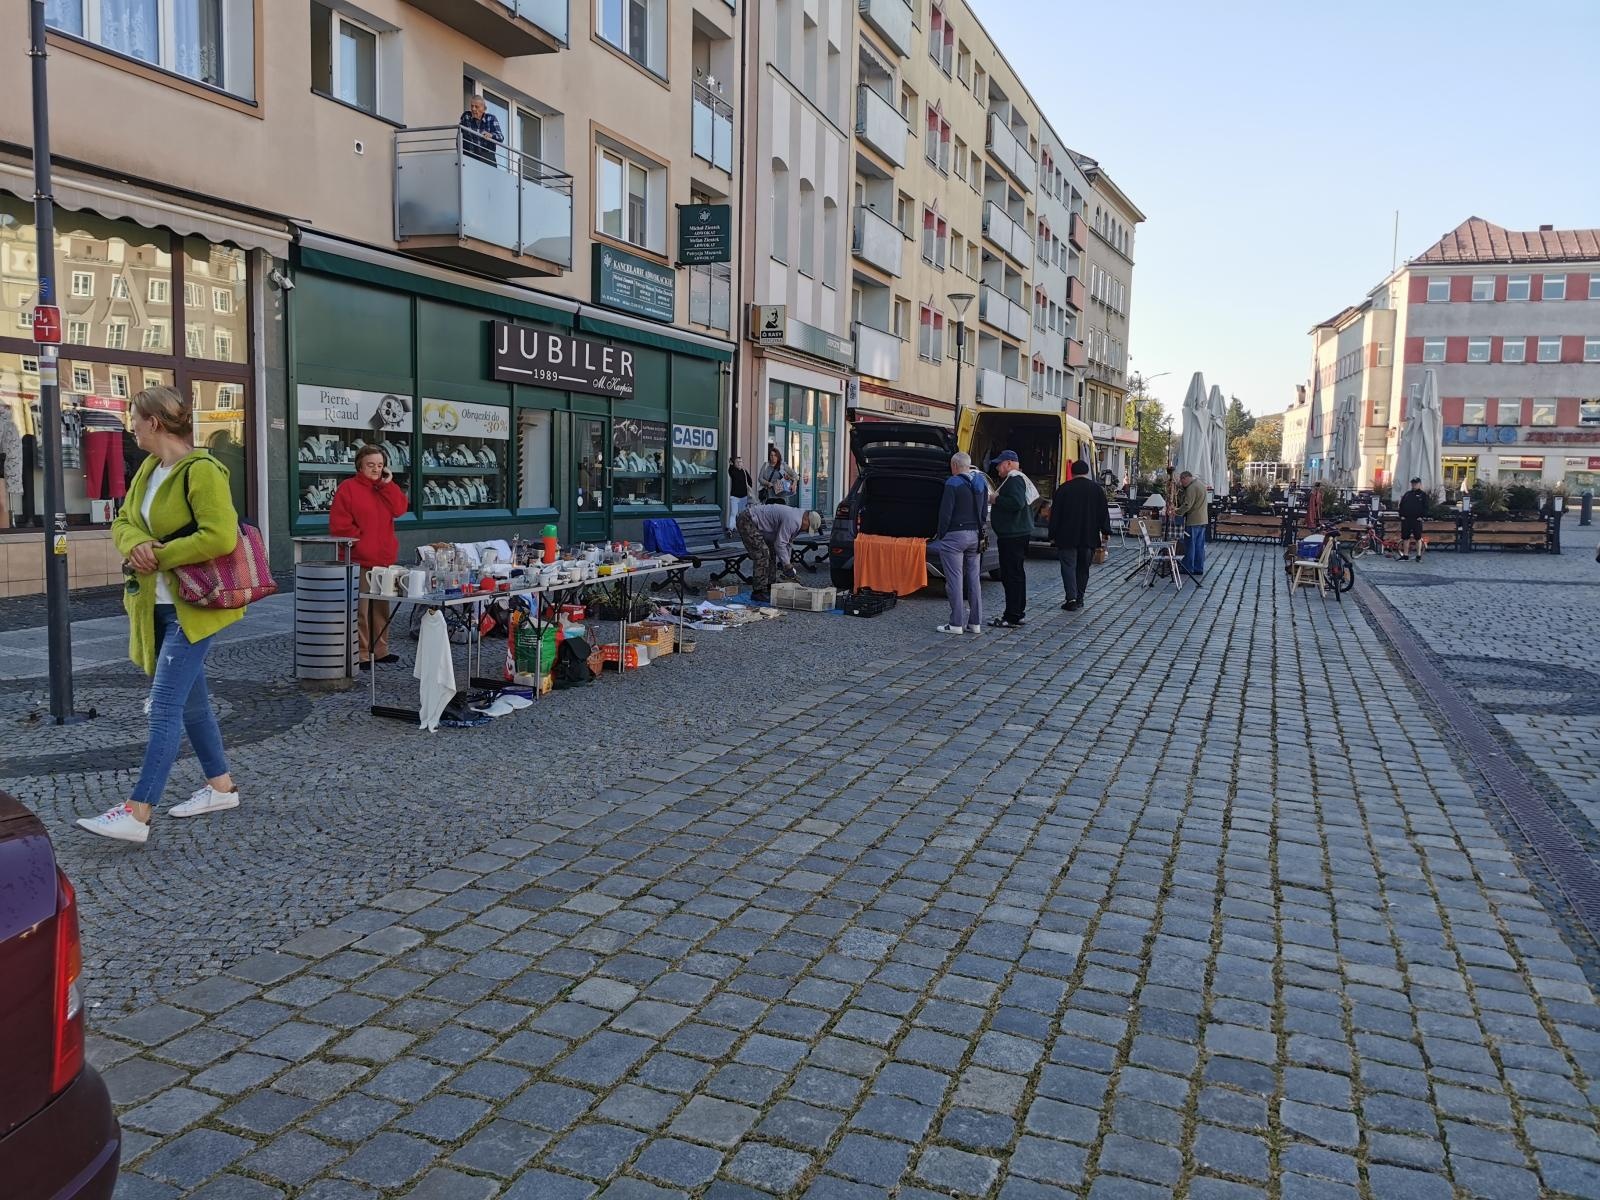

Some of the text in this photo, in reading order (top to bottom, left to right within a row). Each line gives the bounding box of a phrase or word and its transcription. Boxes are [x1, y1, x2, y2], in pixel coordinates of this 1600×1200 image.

[613, 260, 645, 277] KANCELARIE
[498, 325, 633, 377] JUBILER
[533, 368, 558, 382] 1989
[319, 390, 350, 406] Pierre
[324, 403, 359, 424] Ricaud
[461, 408, 500, 422] Obrączki do
[483, 419, 508, 434] -30%
[673, 426, 714, 448] CASIO
